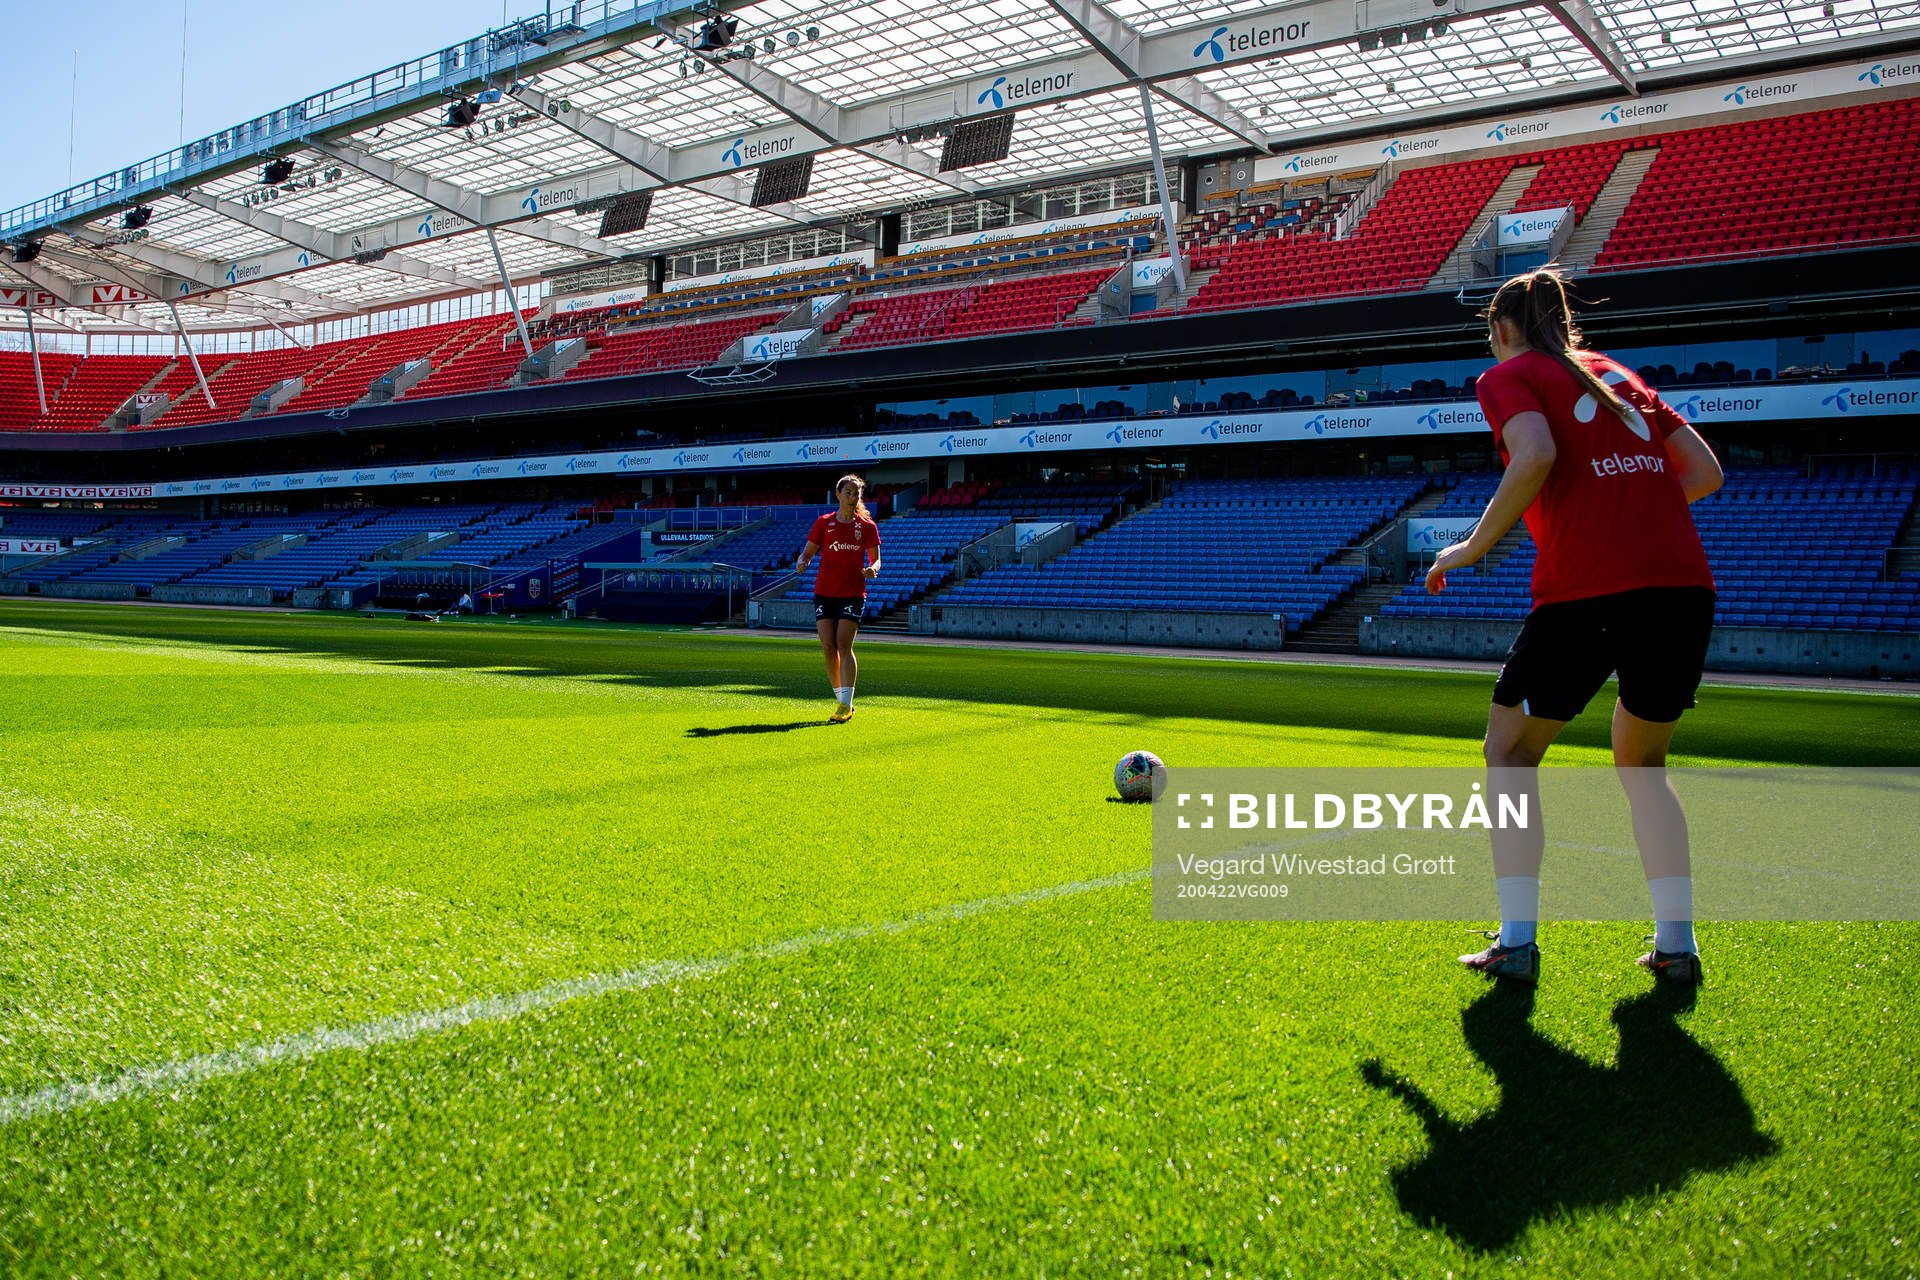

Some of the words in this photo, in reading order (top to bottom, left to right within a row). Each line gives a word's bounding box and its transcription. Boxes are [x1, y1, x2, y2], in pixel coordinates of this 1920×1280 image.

[1229, 18, 1310, 52] telenor
[1007, 69, 1074, 100] telenor
[1745, 82, 1798, 99] telenor
[1620, 102, 1668, 118] telenor
[1504, 120, 1550, 136] telenor
[744, 135, 795, 159] telenor
[1398, 138, 1439, 153] telenor
[1300, 154, 1339, 168] telenor
[1522, 220, 1559, 232] teleno
[236, 264, 262, 279] telenor
[1849, 389, 1918, 405] telenor
[1700, 397, 1762, 412] telenor
[1437, 409, 1488, 424] teleno
[1218, 421, 1263, 436] telenor
[1323, 416, 1372, 430] telenor
[1034, 431, 1072, 444] telenor
[1123, 426, 1164, 440] telenor
[878, 440, 910, 452] telenor
[953, 436, 988, 448] telenor
[743, 449, 771, 460] telenor
[808, 445, 838, 456] telenor
[575, 460, 598, 468] telenor
[627, 456, 651, 466] telenor
[683, 453, 709, 463] telenor
[480, 465, 500, 474] telenor
[526, 462, 548, 471] telenor
[1590, 452, 1665, 478] telenor
[397, 471, 415, 479] telenor
[437, 469, 456, 477] telenor
[26, 487, 61, 496] VG
[65, 488, 96, 497] VG
[100, 488, 127, 497] VG
[129, 487, 152, 496] VG
[21, 543, 56, 552] VG
